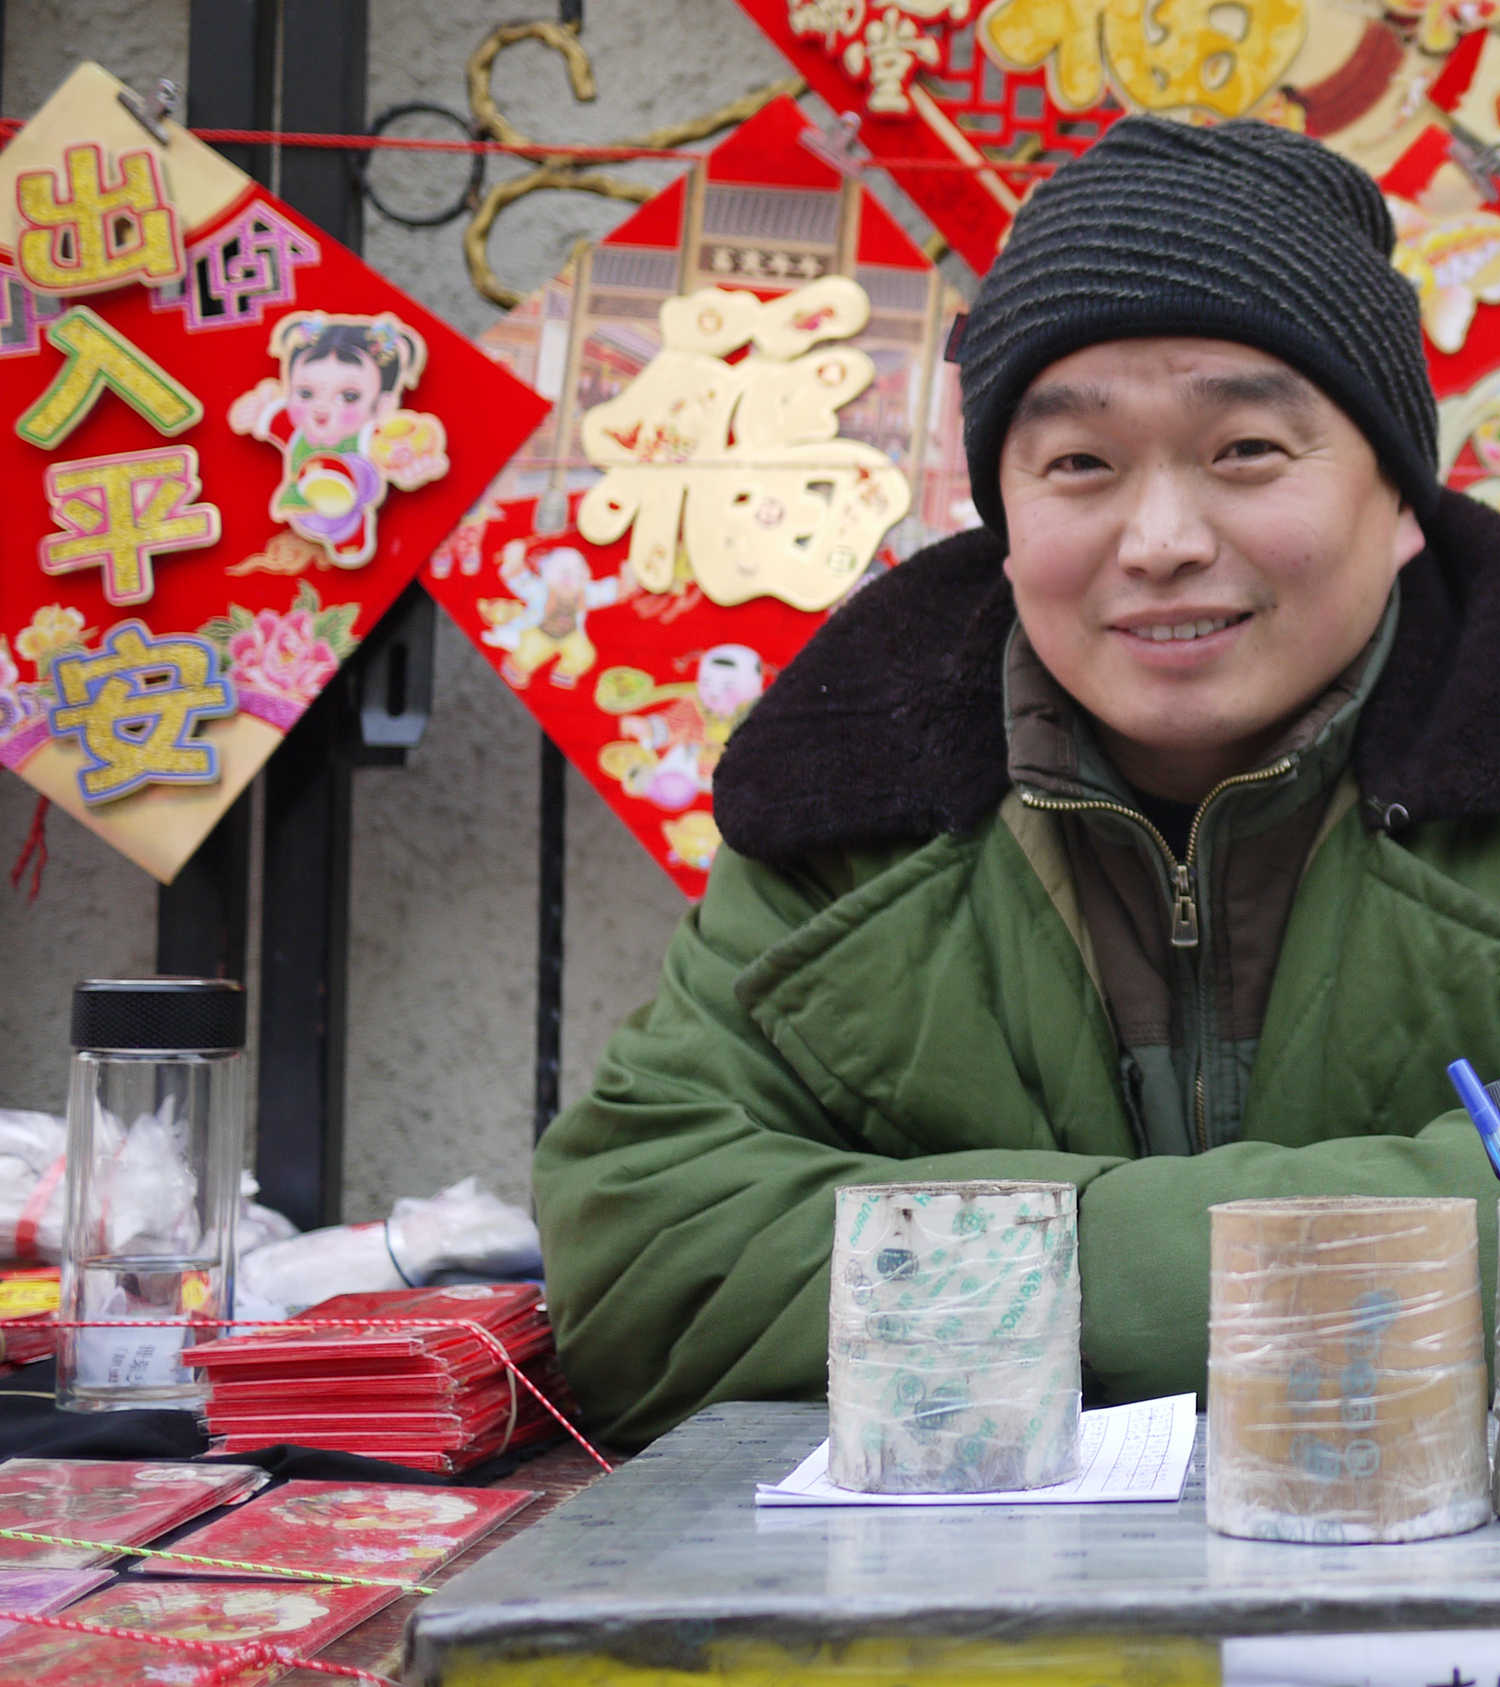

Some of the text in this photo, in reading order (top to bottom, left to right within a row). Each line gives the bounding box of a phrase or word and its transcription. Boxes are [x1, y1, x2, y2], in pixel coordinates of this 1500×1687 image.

[16, 143, 238, 806] 出入平安
[579, 276, 912, 612] 福
